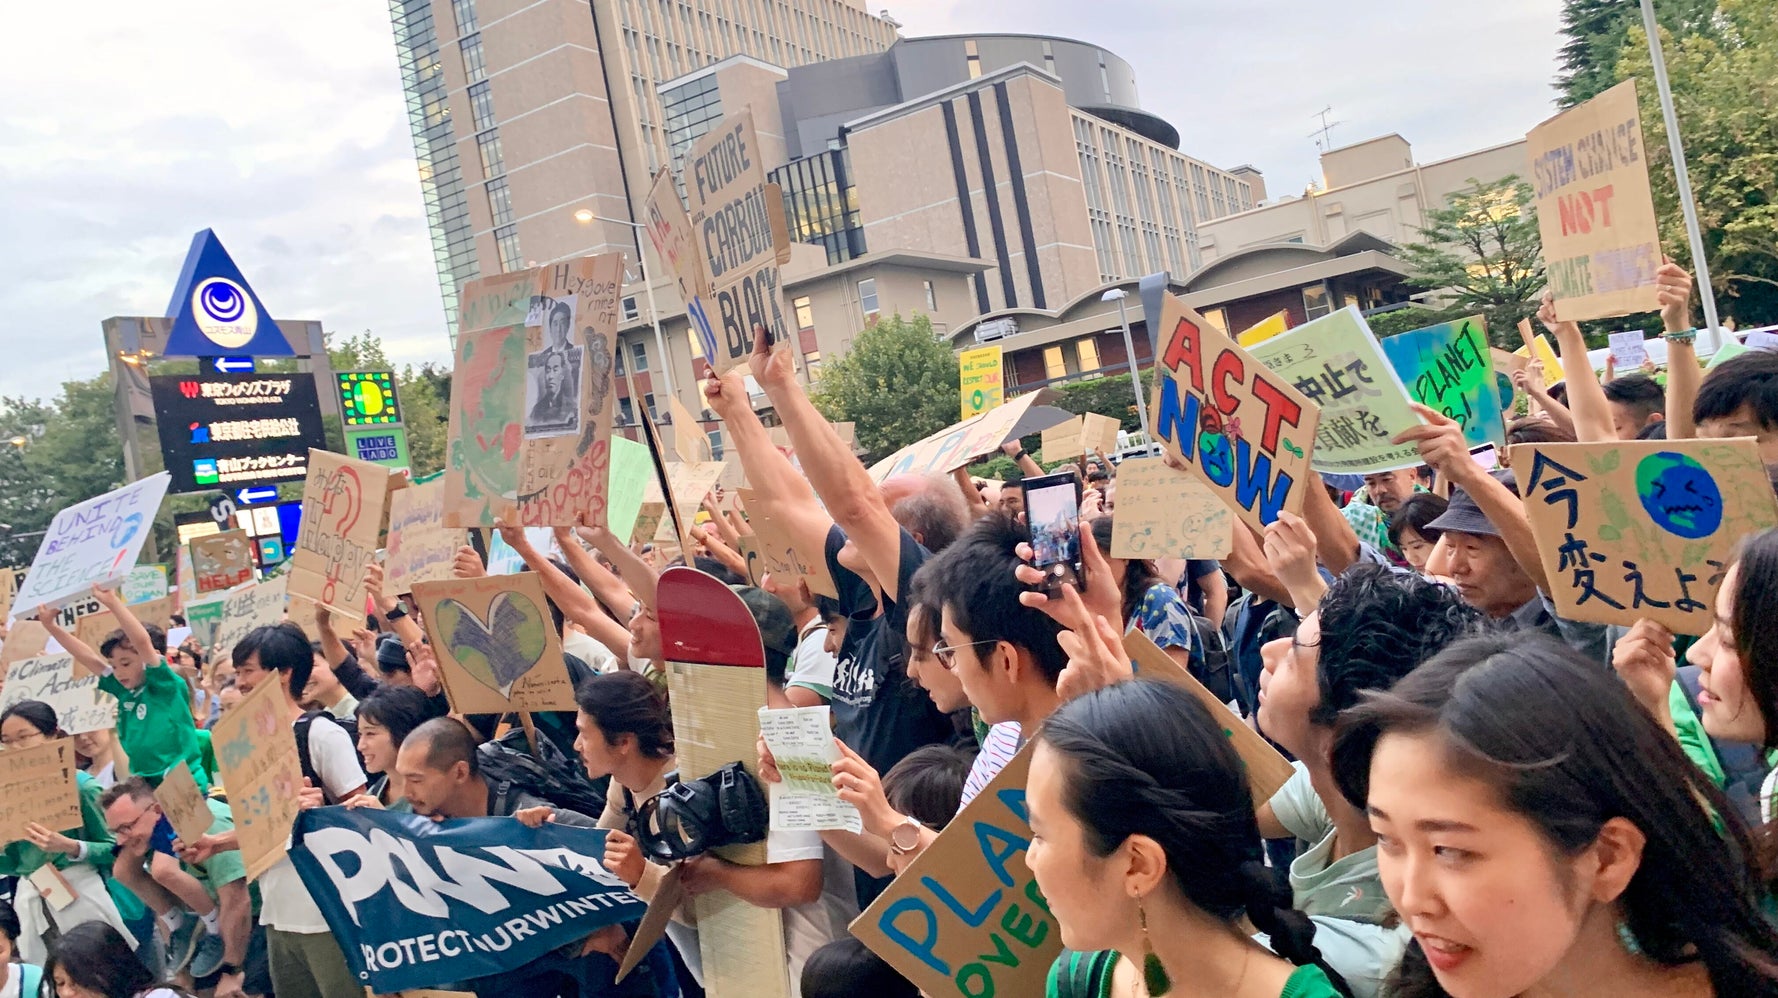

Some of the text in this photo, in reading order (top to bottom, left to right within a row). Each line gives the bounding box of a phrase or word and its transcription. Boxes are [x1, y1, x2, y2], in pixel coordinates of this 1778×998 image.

[694, 123, 750, 205] FUTURE
[703, 182, 774, 278] CARBON
[1558, 184, 1615, 237] NOT
[717, 267, 790, 359] BLACK
[1163, 316, 1301, 459] ACT
[1416, 321, 1486, 406] PLANET
[216, 454, 305, 472] 青山ブックセンター
[358, 437, 394, 448] LIVE
[360, 449, 396, 460] LABO
[1157, 376, 1294, 528] NOW
[57, 487, 144, 536] UNITE
[1526, 449, 1588, 529] 今
[46, 516, 123, 555] BEHIND
[35, 552, 77, 579] THE
[199, 568, 255, 591] HELP
[37, 673, 96, 697] Action
